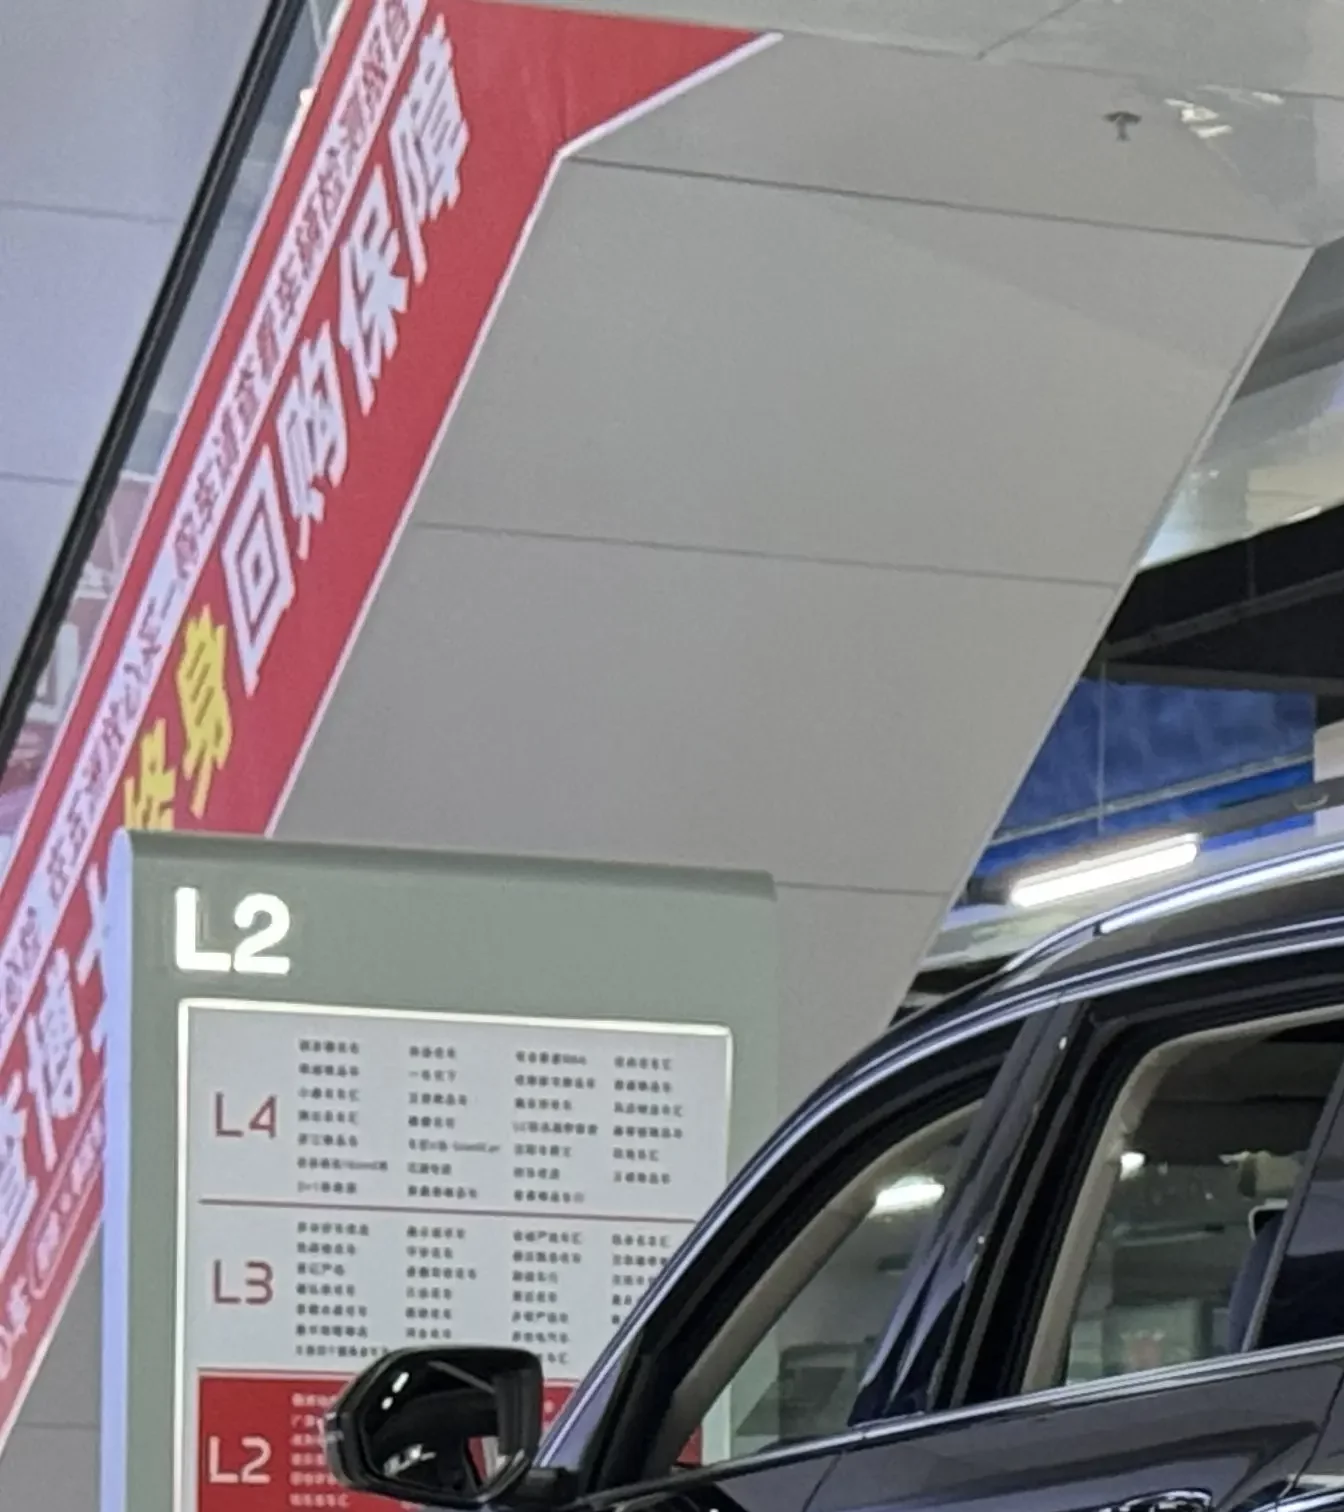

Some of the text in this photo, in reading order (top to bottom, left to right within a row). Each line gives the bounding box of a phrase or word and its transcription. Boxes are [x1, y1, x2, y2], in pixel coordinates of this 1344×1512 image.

[173, 886, 291, 975] L2
[213, 1092, 279, 1139] L4
[212, 1259, 275, 1305] L3
[207, 1435, 273, 1484] L2
